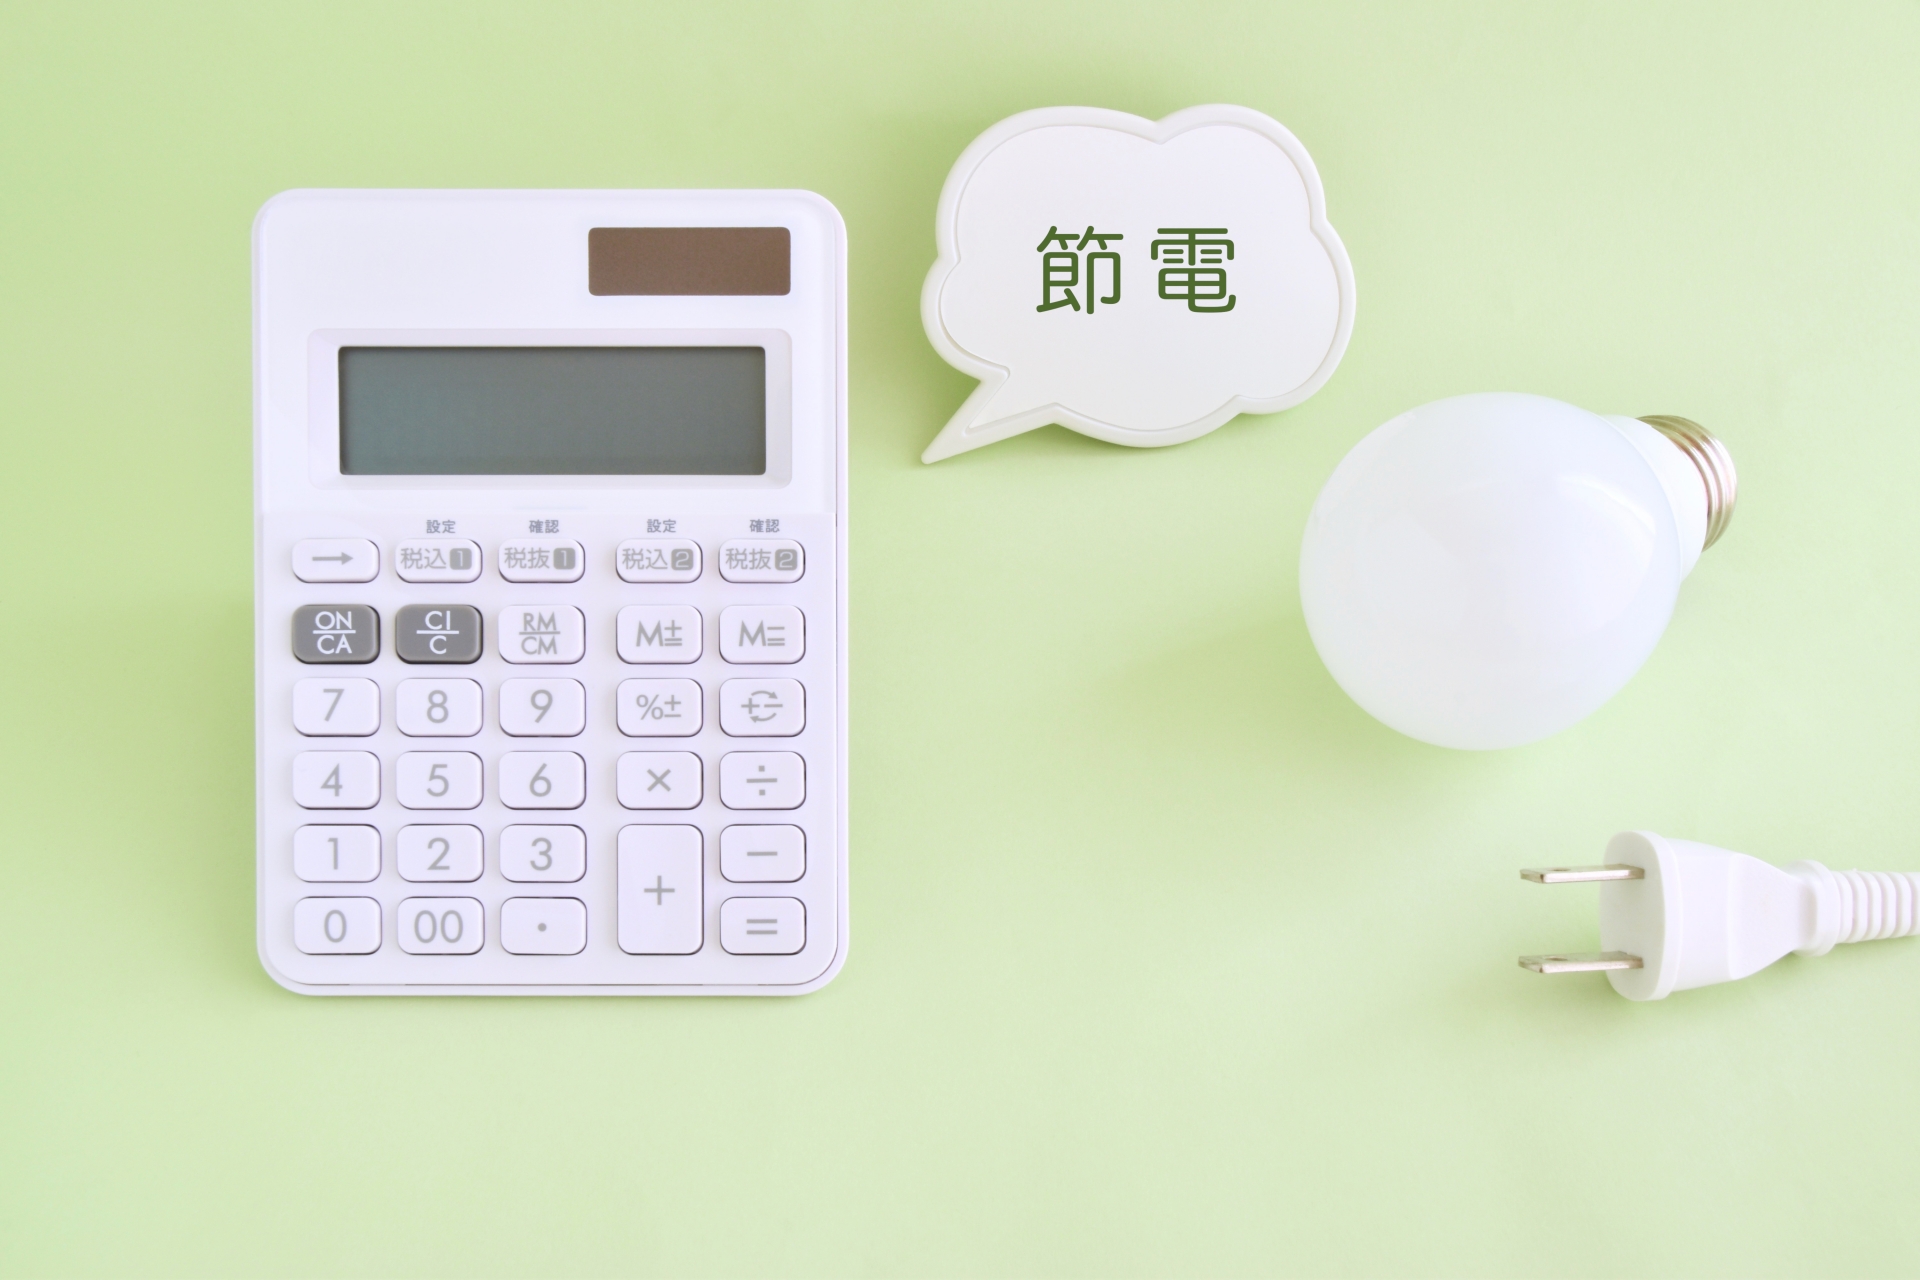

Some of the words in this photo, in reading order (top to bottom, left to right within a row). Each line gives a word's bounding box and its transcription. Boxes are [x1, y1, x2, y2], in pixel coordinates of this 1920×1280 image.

[1036, 226, 1236, 314] 節電
[426, 520, 456, 534] 設定
[529, 519, 560, 534] 確認
[646, 519, 677, 533] 設定
[749, 519, 780, 533] 確認
[315, 611, 352, 630] ON
[523, 612, 557, 631] RM
[316, 634, 353, 655] CA
[429, 635, 447, 654] C
[521, 636, 558, 655] CM
[323, 689, 344, 722] 7
[427, 690, 449, 723] 8
[530, 689, 553, 723] 9
[320, 764, 343, 797] 4
[427, 764, 449, 797] 5
[529, 763, 552, 797] 6
[327, 838, 338, 870] 1
[427, 837, 450, 870] 2
[530, 837, 552, 871] 3
[324, 910, 347, 943] 0
[414, 910, 463, 943] 00
